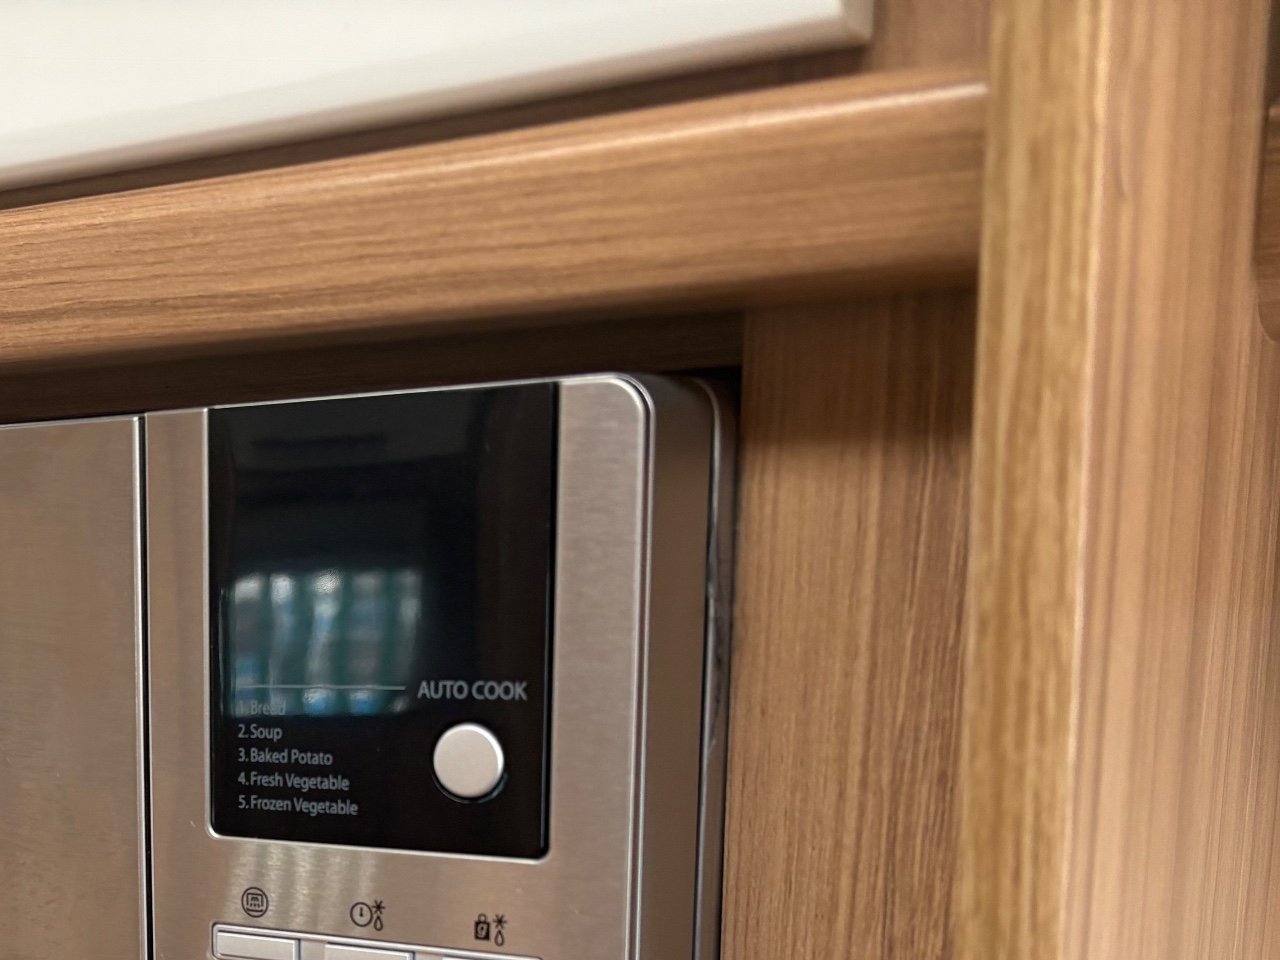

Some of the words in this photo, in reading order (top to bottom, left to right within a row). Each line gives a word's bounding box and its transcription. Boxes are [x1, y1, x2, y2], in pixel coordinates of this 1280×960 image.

[418, 680, 469, 701] AUTO
[472, 681, 528, 701] COOK
[291, 749, 333, 766] Potato
[285, 773, 350, 792] Vegetable
[293, 797, 359, 817] Vegetable
